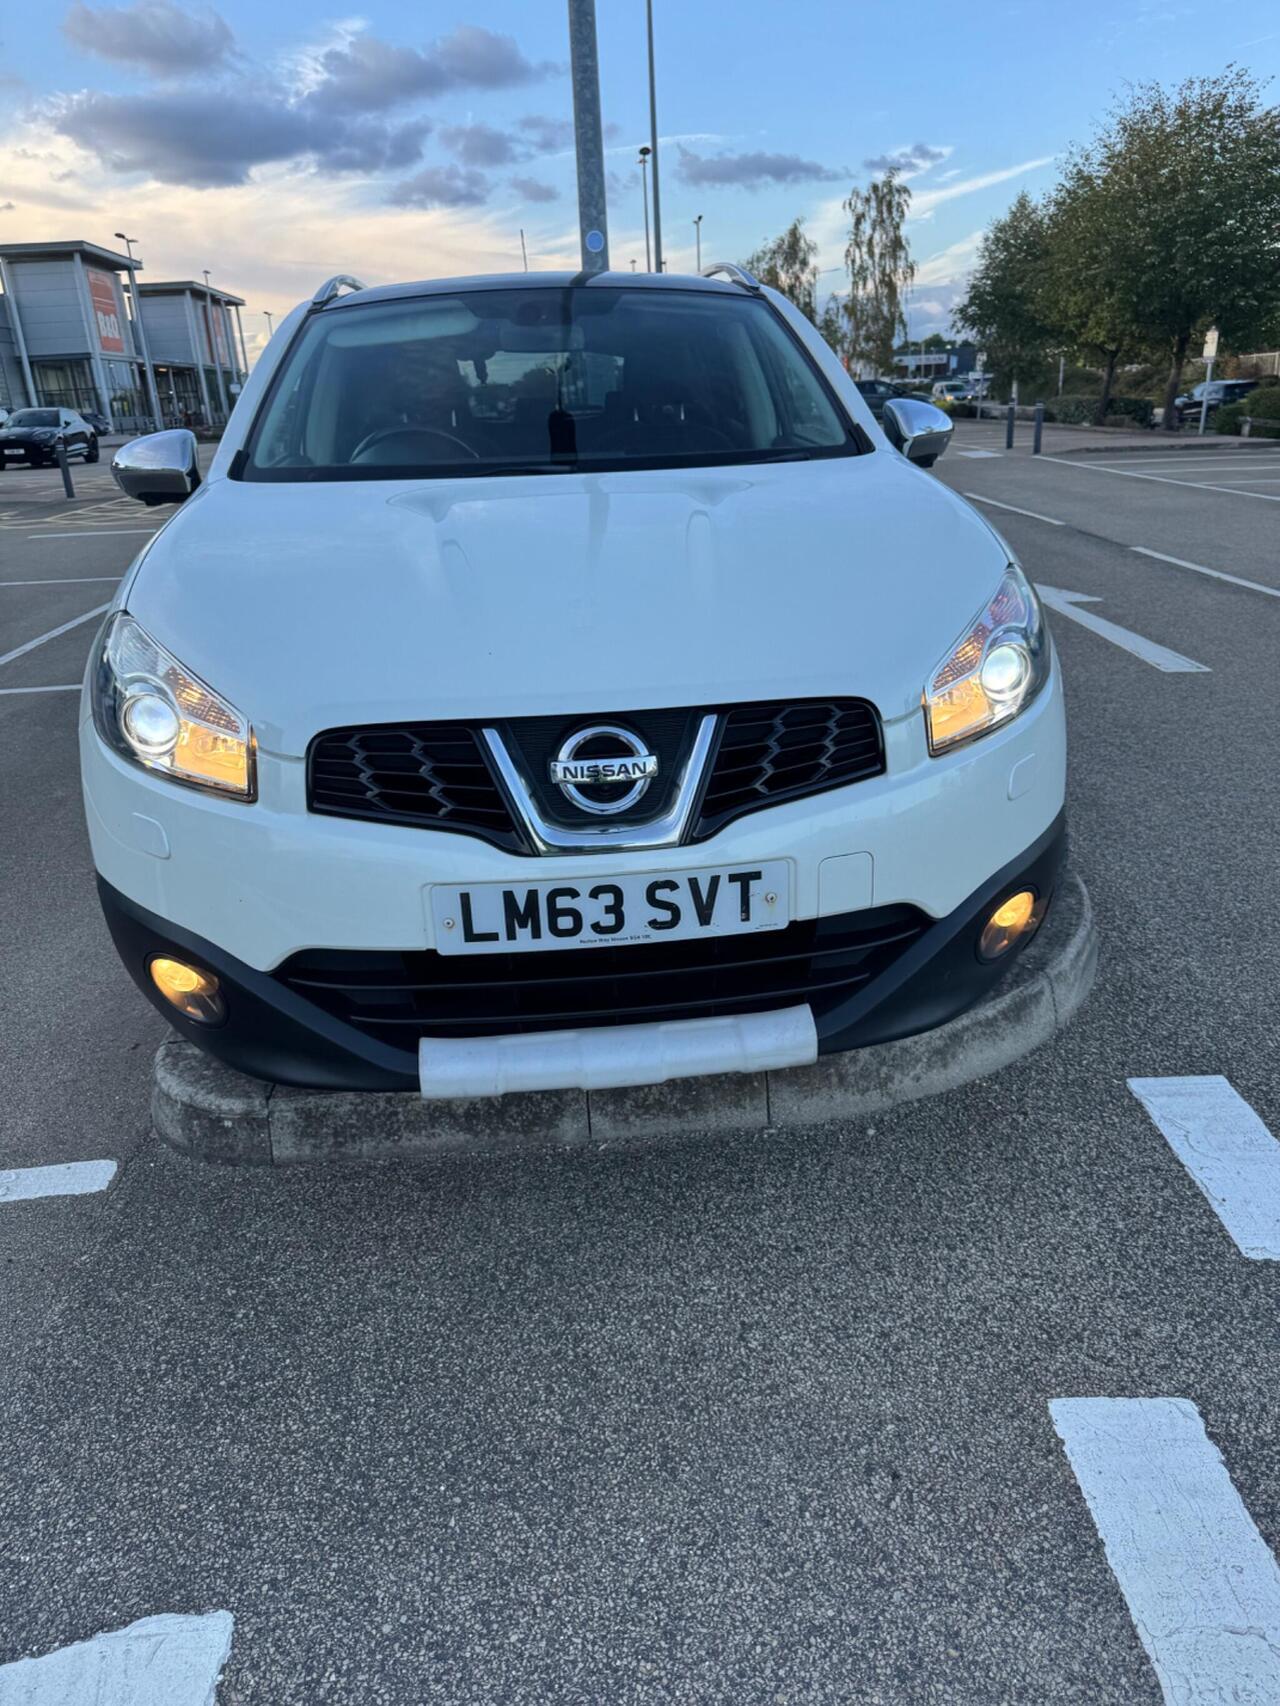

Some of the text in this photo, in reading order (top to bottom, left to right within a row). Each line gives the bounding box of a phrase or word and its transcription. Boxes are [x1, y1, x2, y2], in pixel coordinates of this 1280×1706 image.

[562, 761, 647, 779] NISSAN
[459, 870, 763, 943] LM63 SVT
